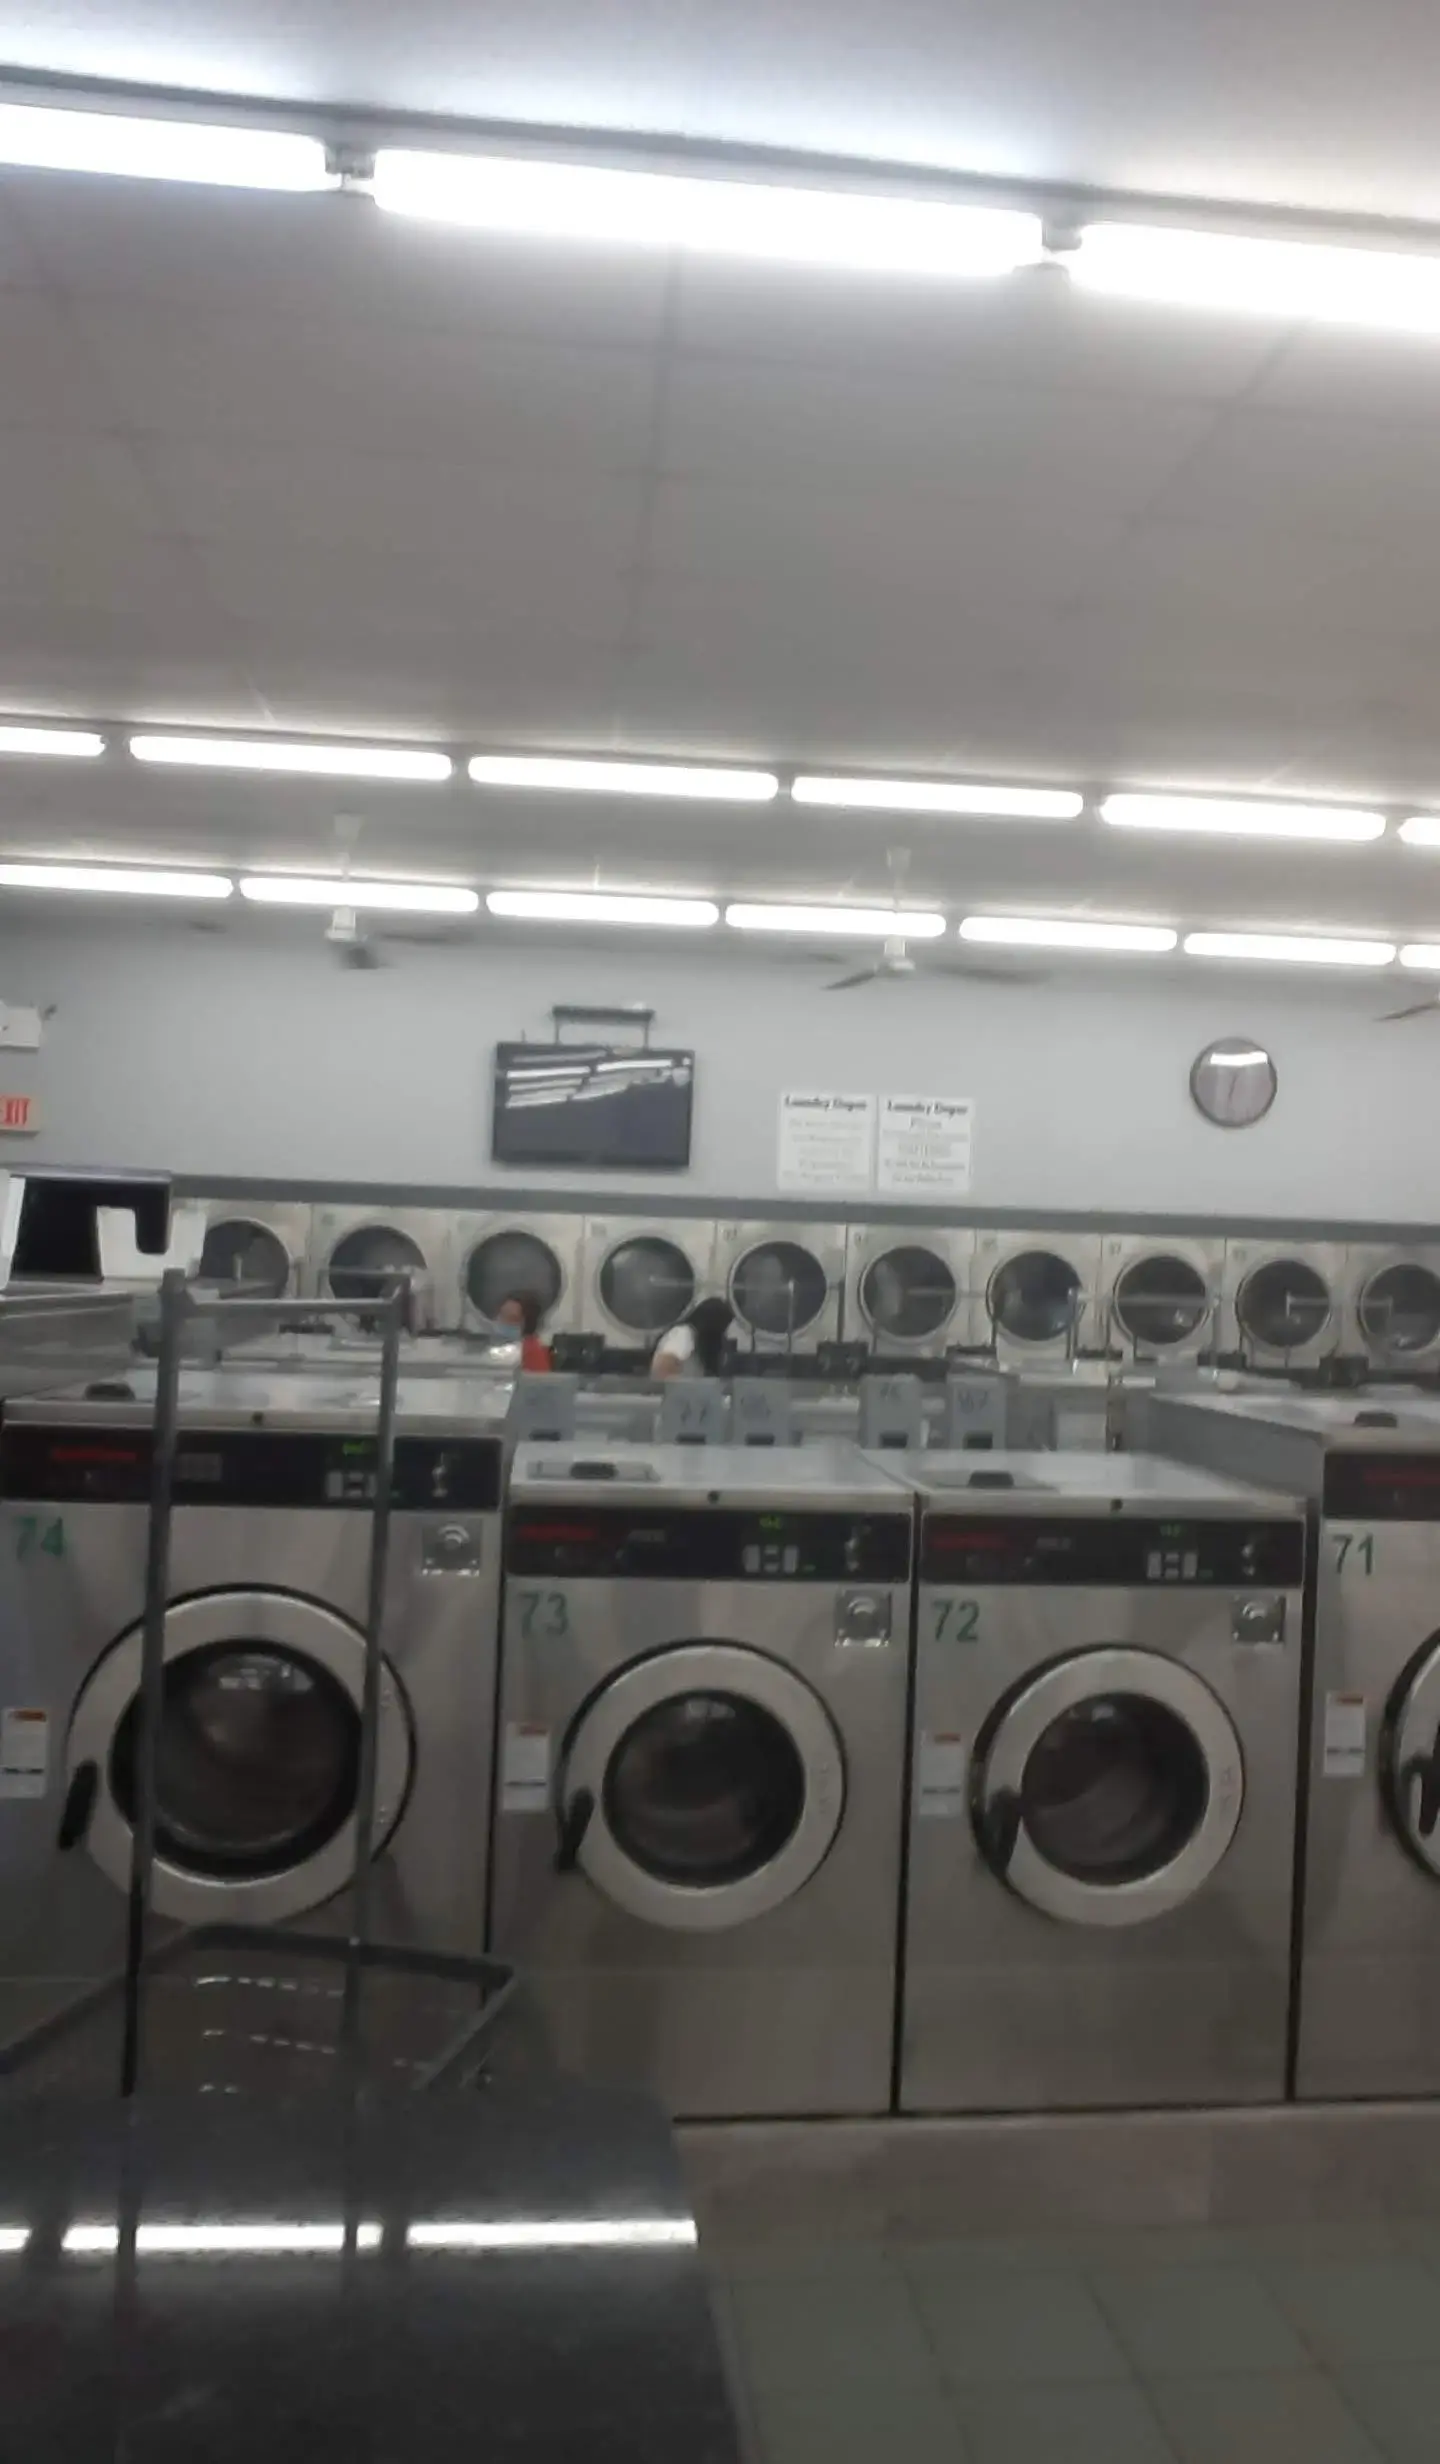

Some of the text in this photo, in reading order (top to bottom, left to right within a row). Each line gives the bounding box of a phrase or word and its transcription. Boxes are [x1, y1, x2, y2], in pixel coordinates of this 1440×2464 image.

[15, 1515, 64, 1560] 74
[1332, 1534, 1375, 1576] 71
[519, 1591, 568, 1637] 73
[931, 1600, 980, 1643] 72
